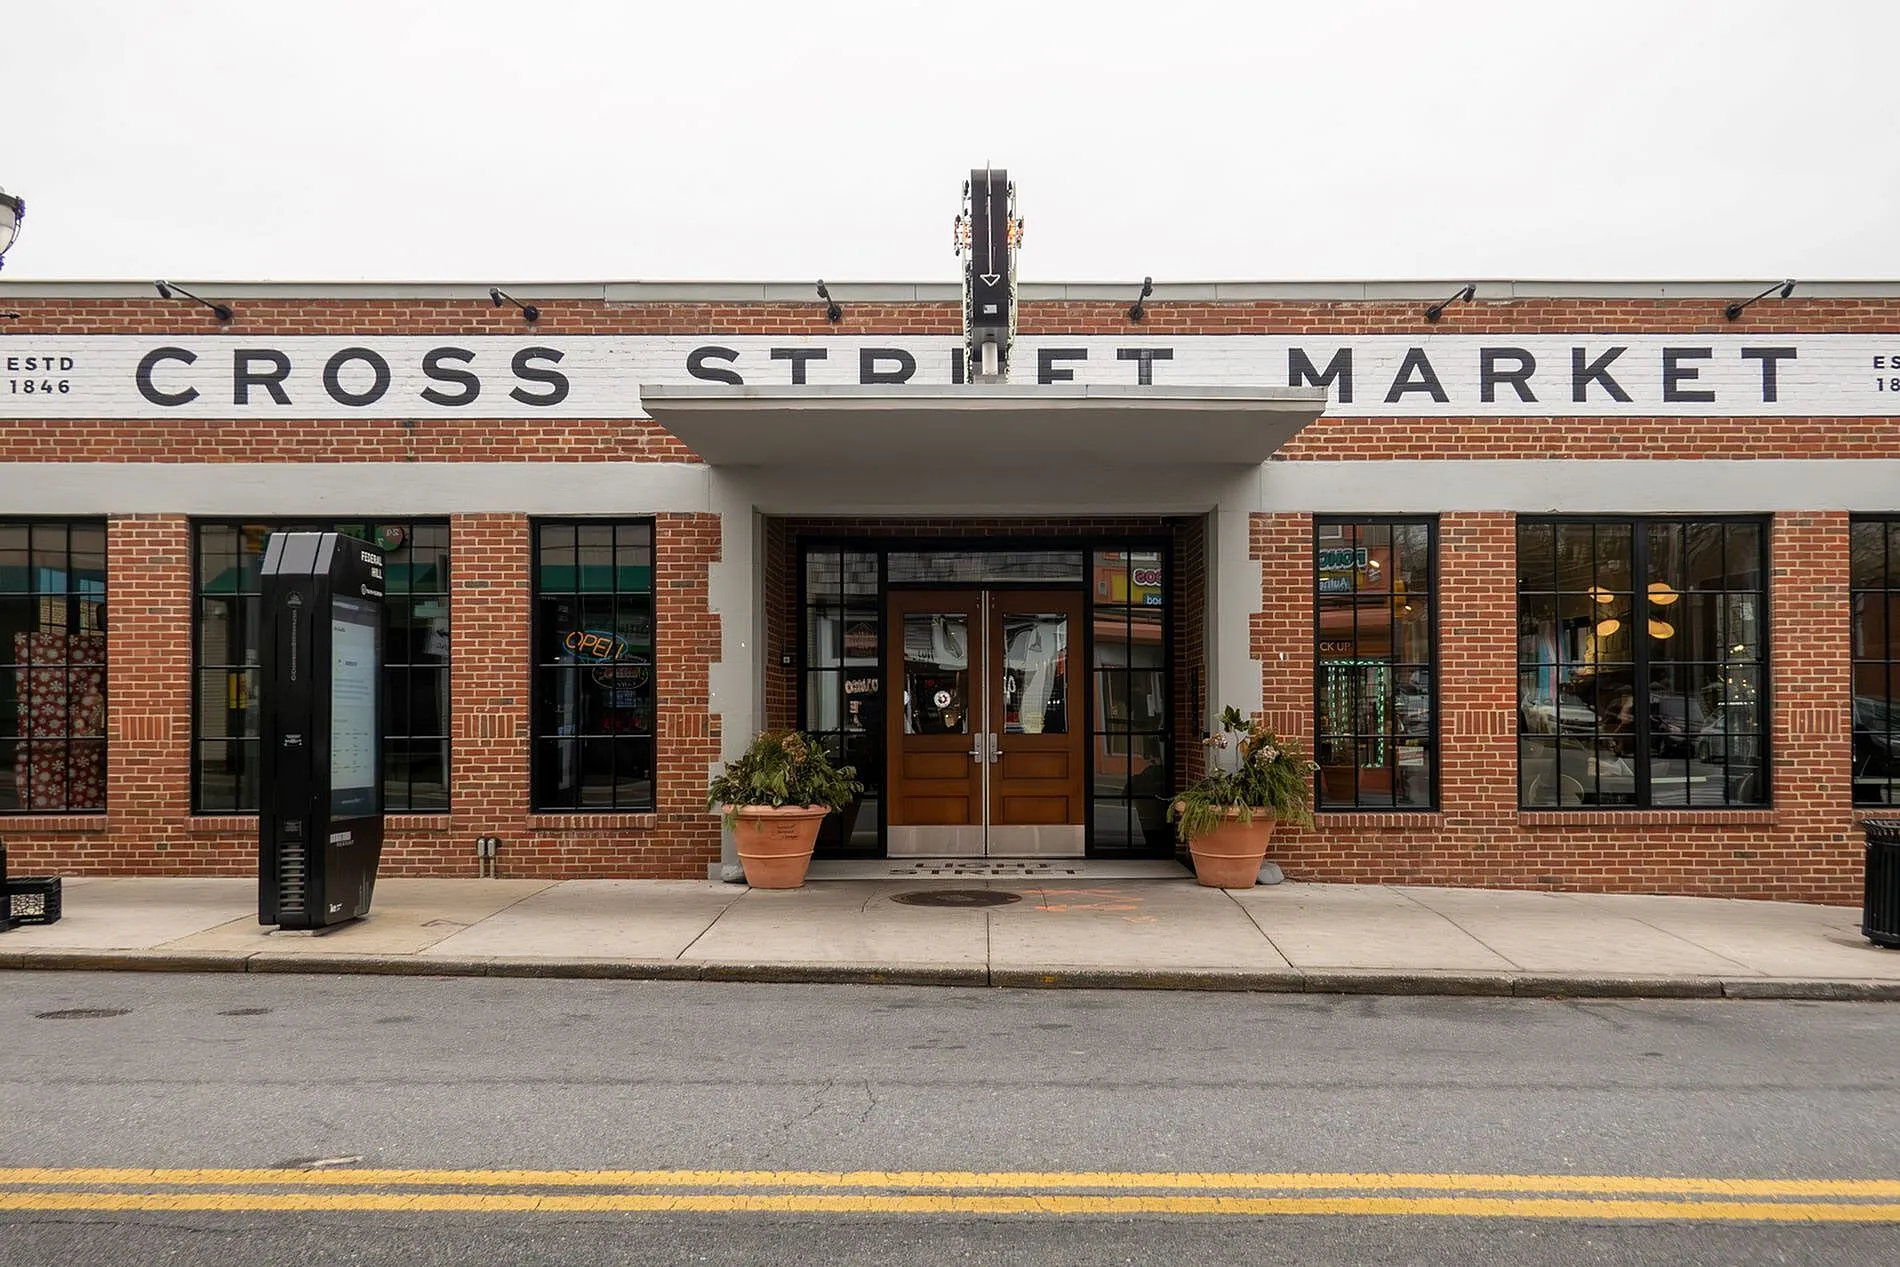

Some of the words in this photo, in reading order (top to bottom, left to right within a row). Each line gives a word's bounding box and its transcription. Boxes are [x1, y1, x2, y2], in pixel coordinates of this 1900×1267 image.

[7, 357, 74, 371] ESTD
[135, 346, 570, 407] CROSS
[686, 346, 1174, 385] STRET
[1287, 346, 1798, 404] MARKET
[9, 379, 71, 394] 1846
[360, 550, 383, 567] FEDERAL
[1336, 641, 1351, 652] UP
